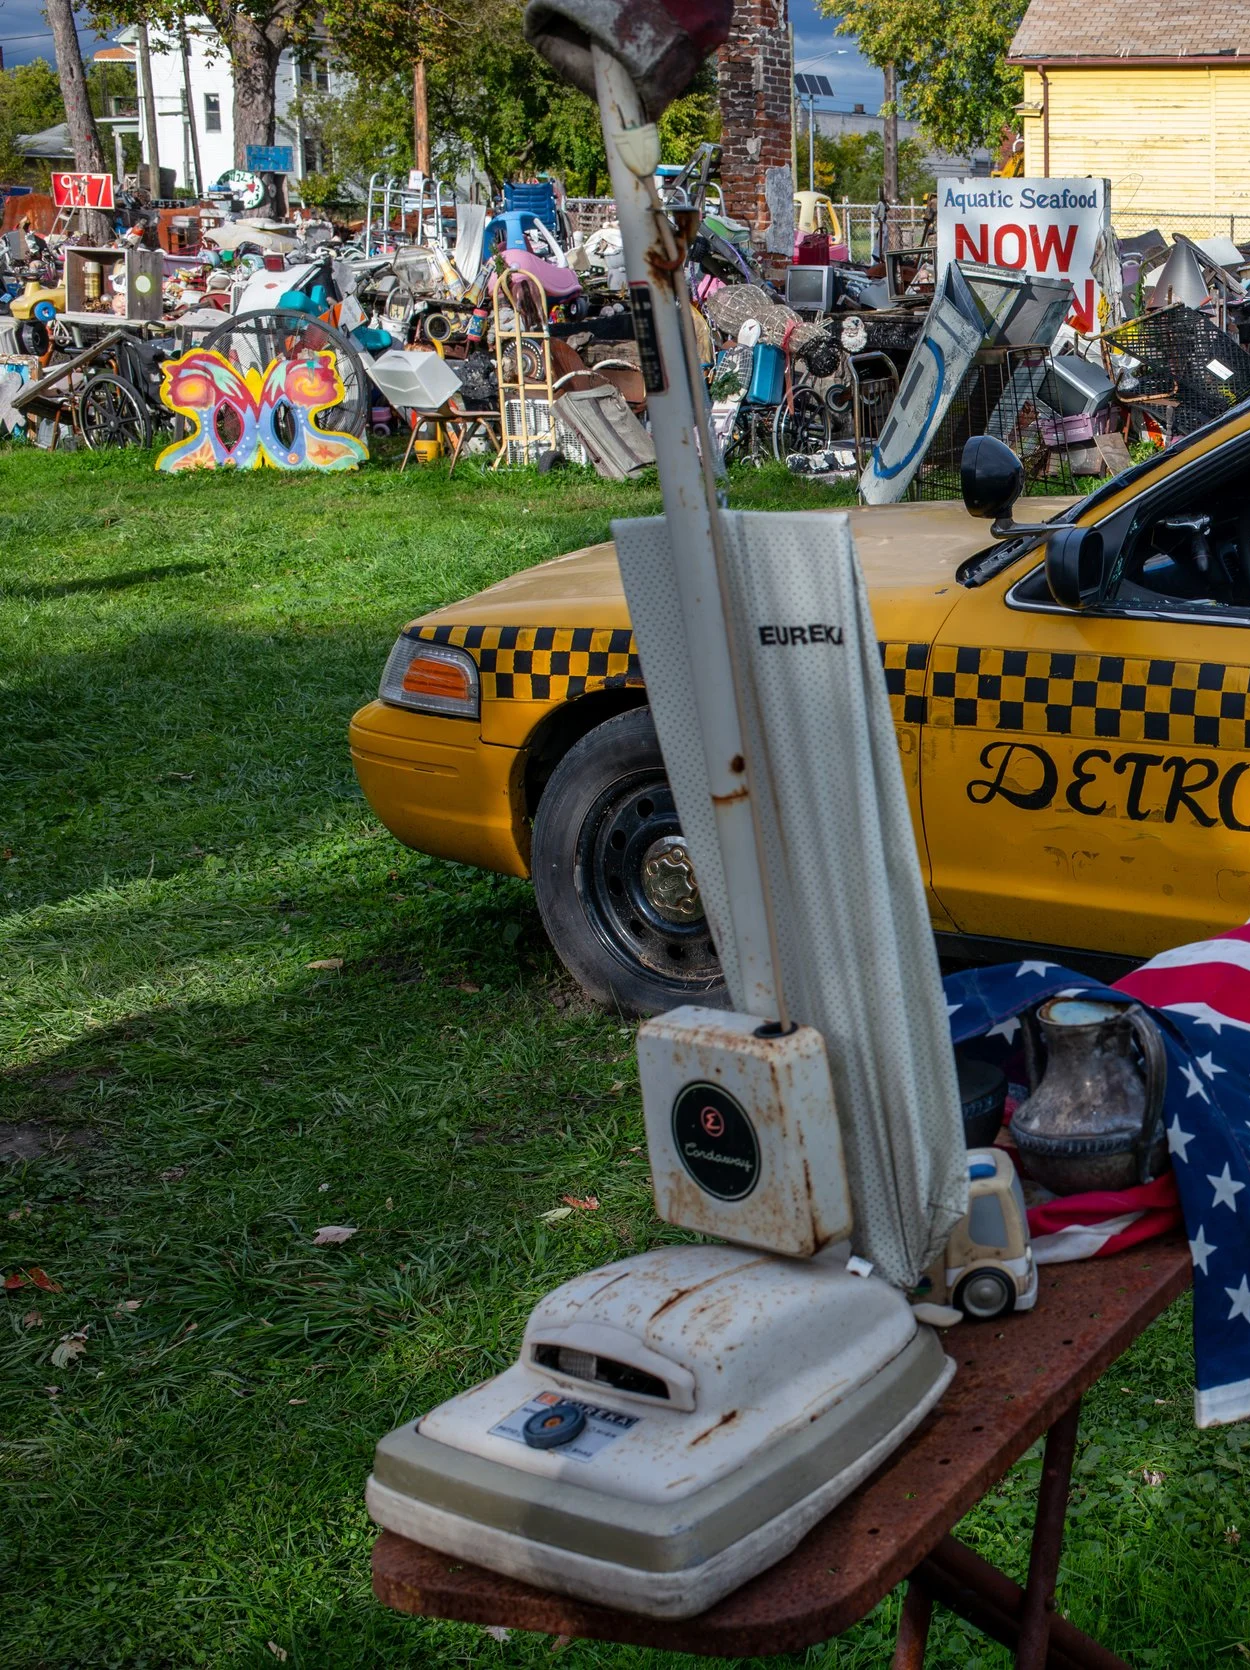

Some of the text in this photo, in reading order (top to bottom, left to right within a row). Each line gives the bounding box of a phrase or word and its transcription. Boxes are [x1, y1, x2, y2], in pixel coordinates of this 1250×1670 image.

[944, 187, 1098, 215] Aquatic Seafood
[954, 223, 1079, 273] NOW
